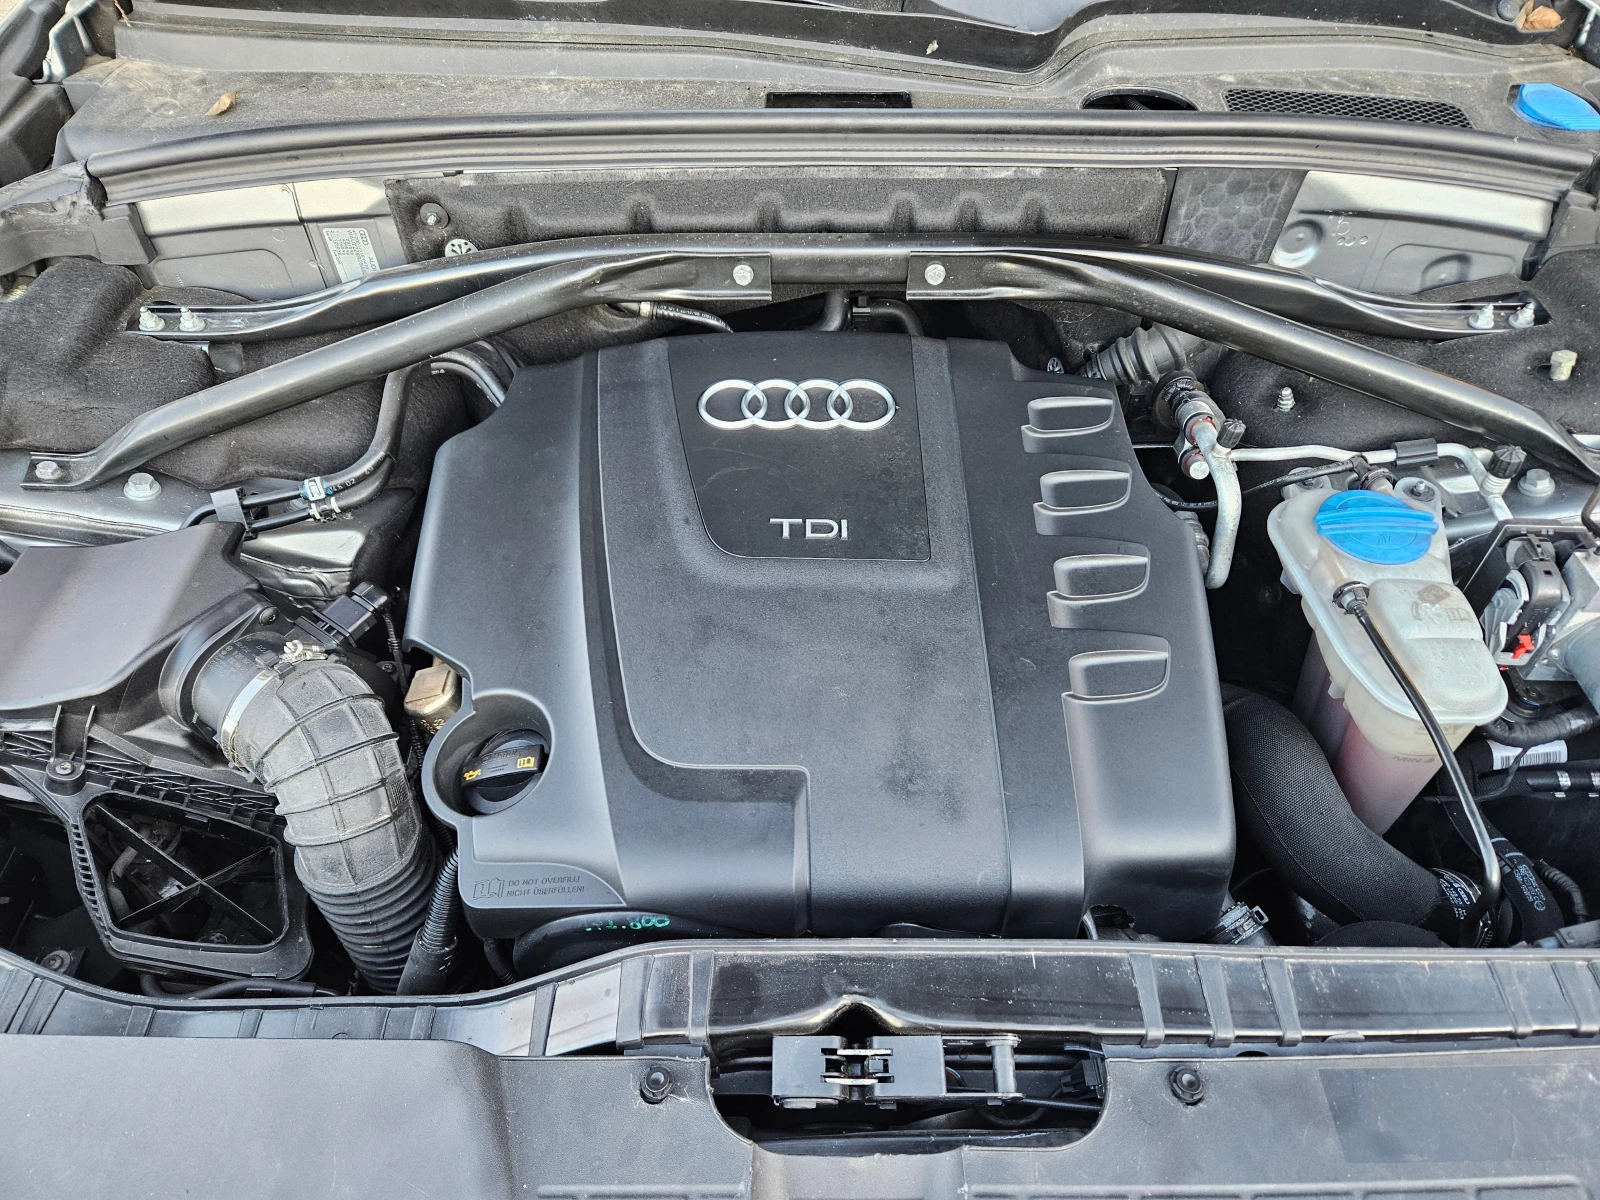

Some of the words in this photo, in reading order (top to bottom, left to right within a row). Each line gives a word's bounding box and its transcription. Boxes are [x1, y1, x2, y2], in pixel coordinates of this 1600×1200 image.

[769, 518, 848, 540] TDI
[1392, 755, 1423, 763] MIN
[522, 878, 540, 886] NOT
[541, 875, 580, 885] OVERFILL!
[506, 888, 531, 897] NICHT
[533, 886, 585, 896] ÜBERFÜLLEN!
